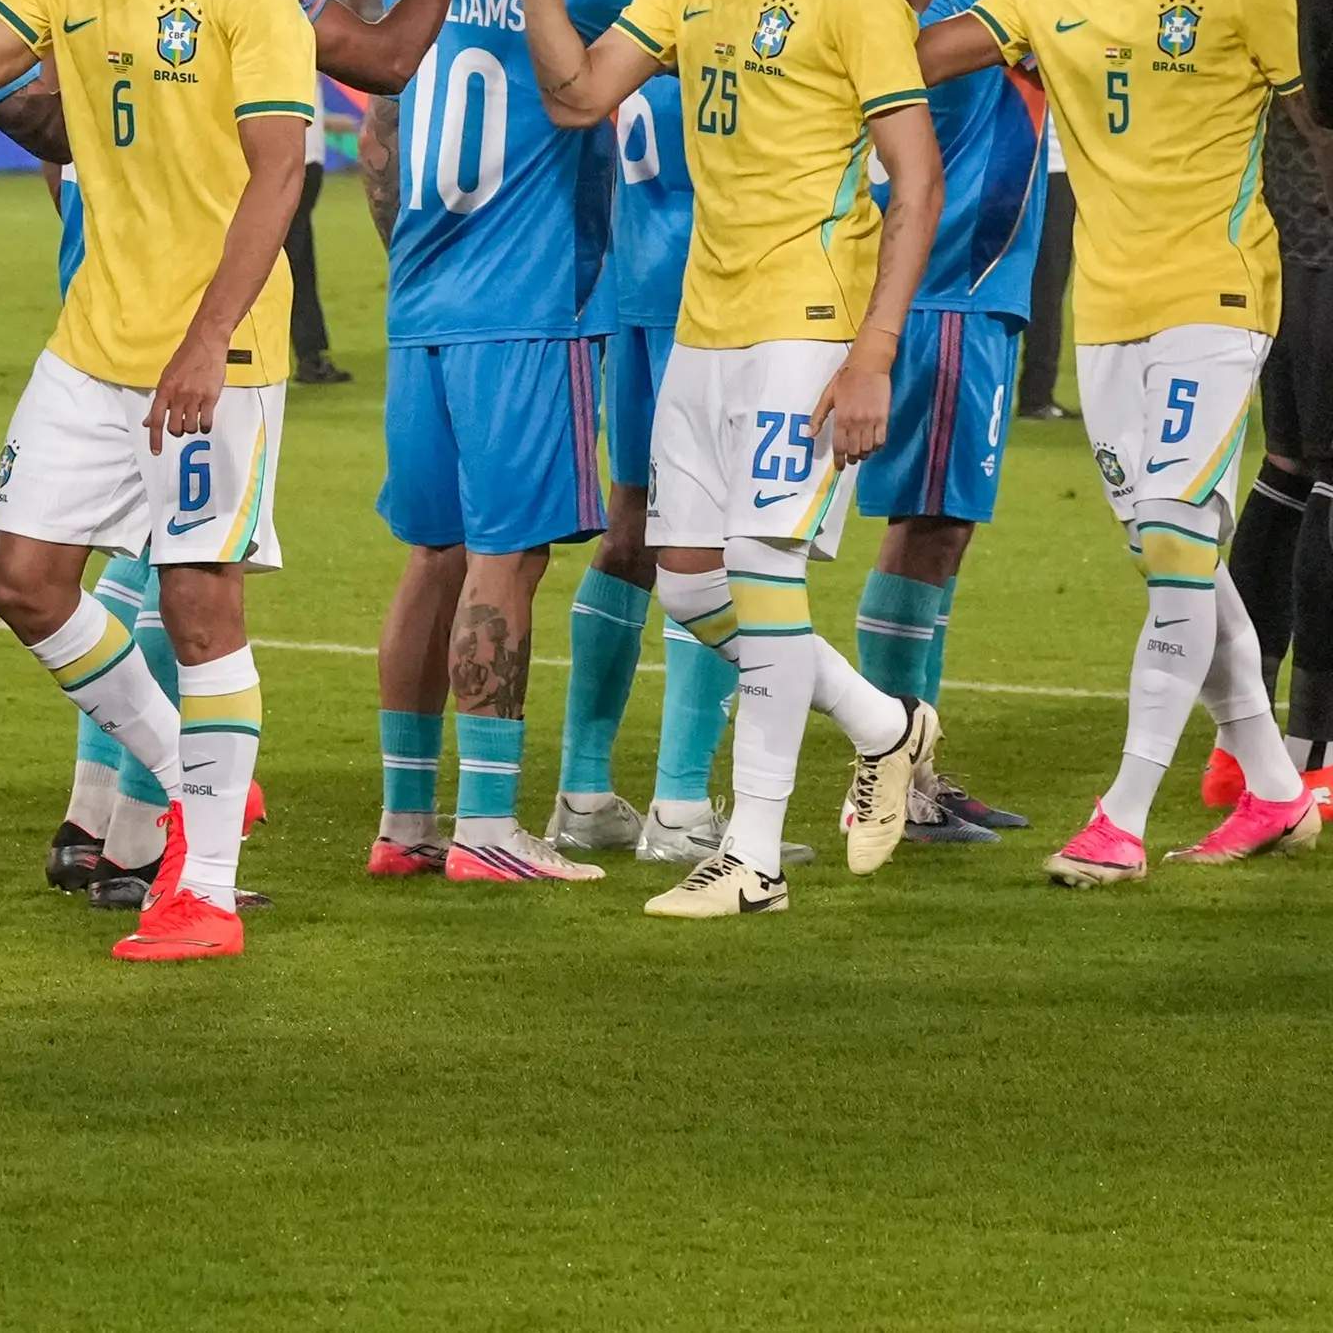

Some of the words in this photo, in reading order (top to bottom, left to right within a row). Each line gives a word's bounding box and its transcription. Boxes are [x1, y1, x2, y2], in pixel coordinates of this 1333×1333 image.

[168, 31, 185, 40] CBF
[763, 25, 778, 36] CBF
[1169, 25, 1186, 34] CBF
[153, 69, 200, 83] BRASIL
[744, 60, 786, 78] BRASIL
[1152, 61, 1199, 74] BRASIL
[697, 66, 737, 136] 25
[1107, 71, 1130, 135] 5
[112, 80, 135, 148] 6
[408, 43, 509, 214] 10
[988, 383, 1005, 448] 8
[1160, 378, 1199, 444] 5
[752, 410, 816, 482] 25
[179, 440, 211, 512] 6
[1111, 486, 1135, 499] BRASI
[1147, 639, 1186, 658] BRASIL
[182, 782, 218, 798] BRASIL
